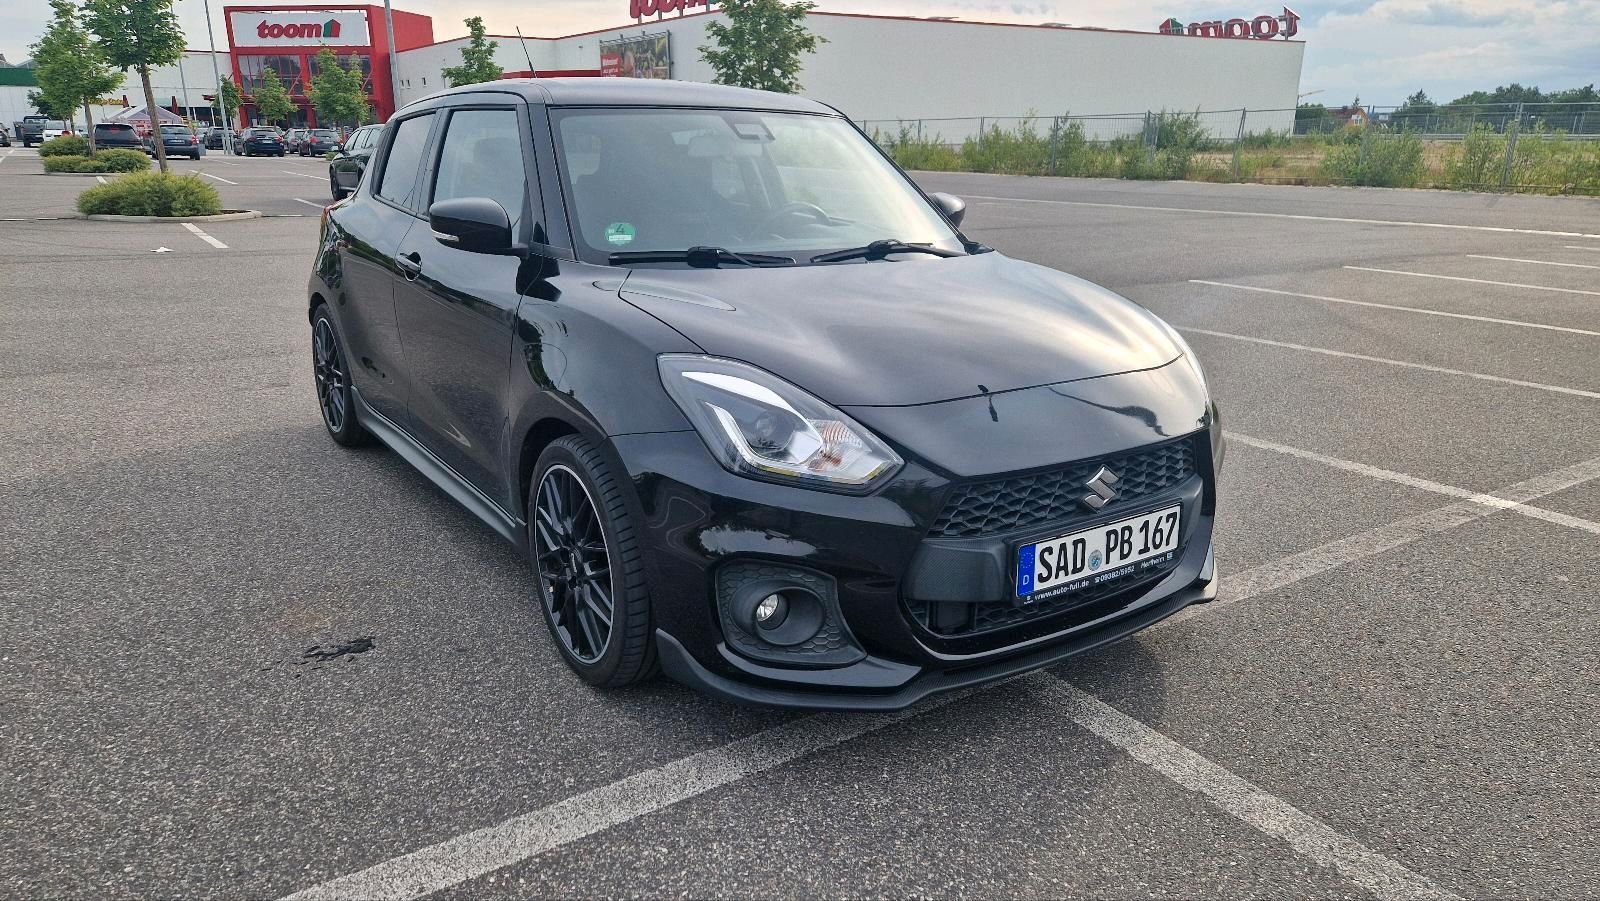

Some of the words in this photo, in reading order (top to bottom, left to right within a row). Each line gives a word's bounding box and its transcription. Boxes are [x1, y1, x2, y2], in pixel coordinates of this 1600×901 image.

[256, 19, 322, 39] toom
[1037, 537, 1087, 584] SAD
[1105, 524, 1134, 565] PB
[1138, 511, 1178, 555] 167
[1022, 574, 1030, 586] D
